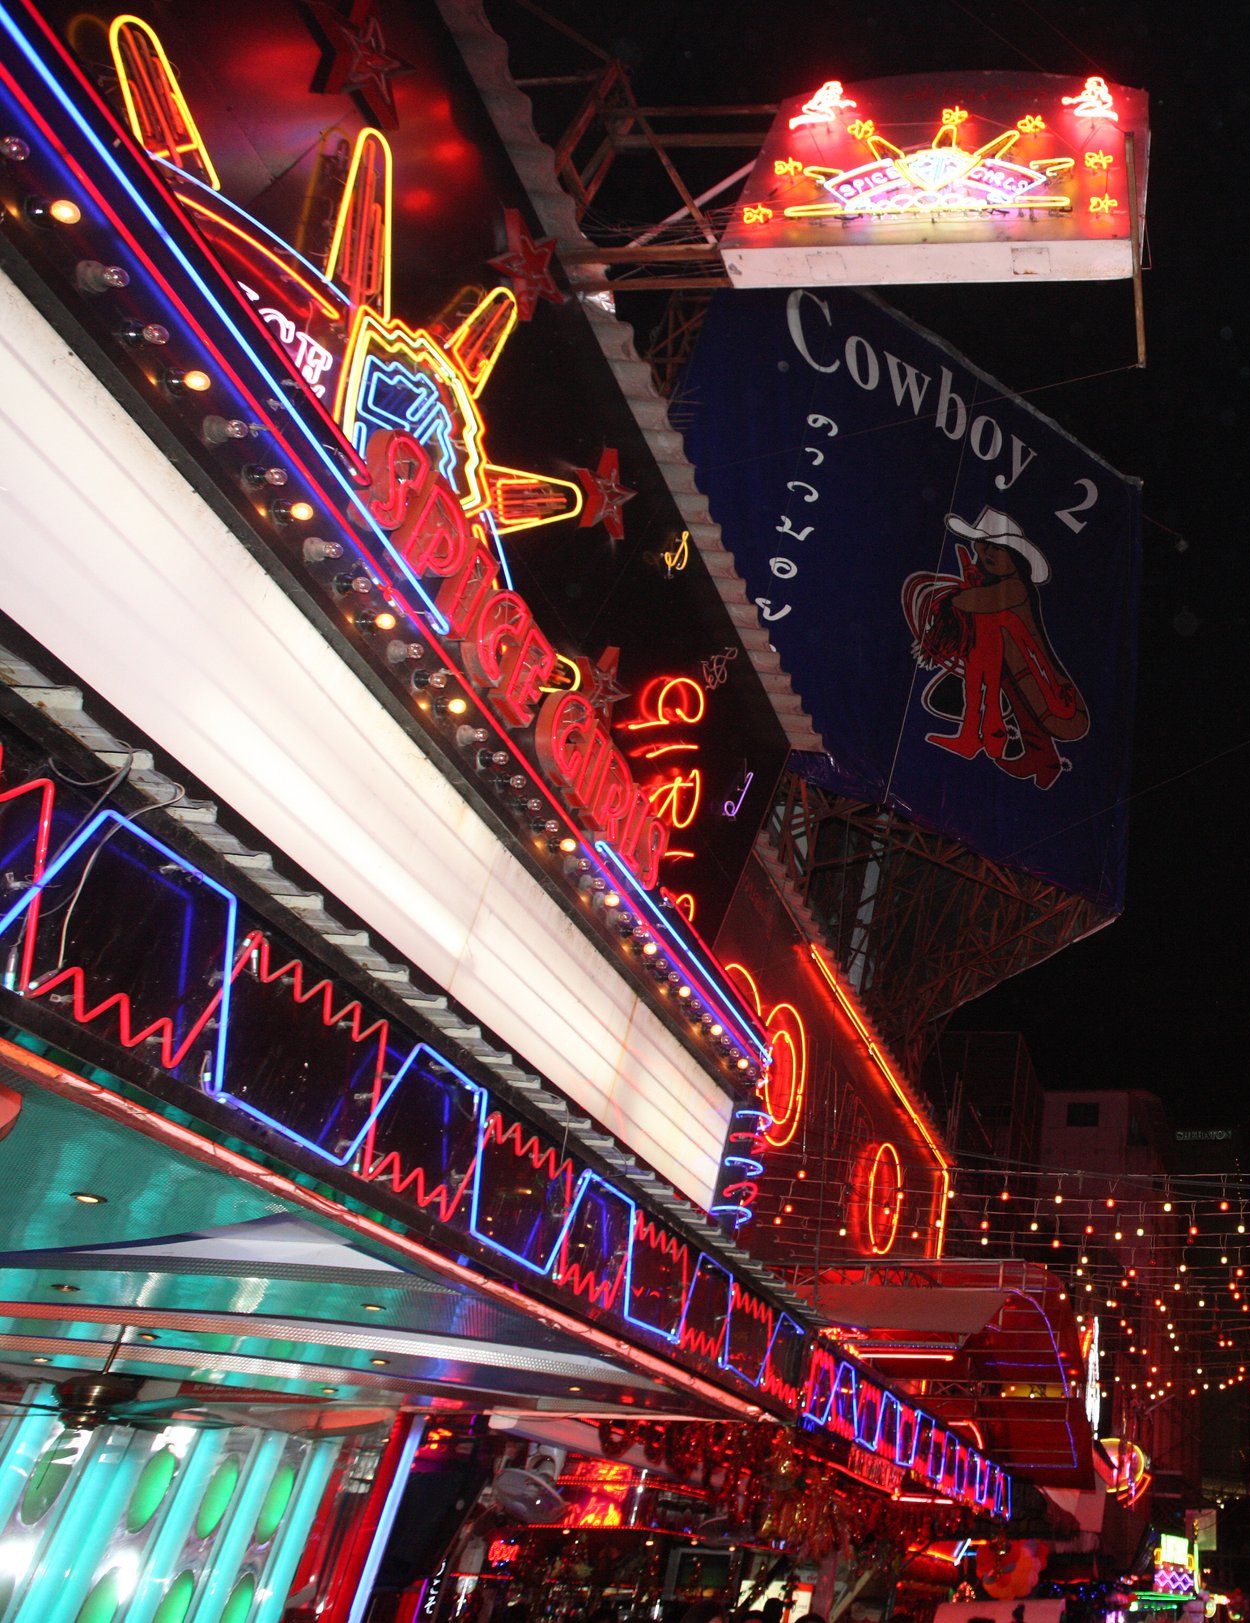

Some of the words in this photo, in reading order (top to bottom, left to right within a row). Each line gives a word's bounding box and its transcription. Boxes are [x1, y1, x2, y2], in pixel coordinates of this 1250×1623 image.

[785, 289, 1038, 491] Cowboy
[1054, 477, 1099, 534] 2
[349, 429, 559, 729] SPICE
[536, 689, 669, 891] GIRLS
